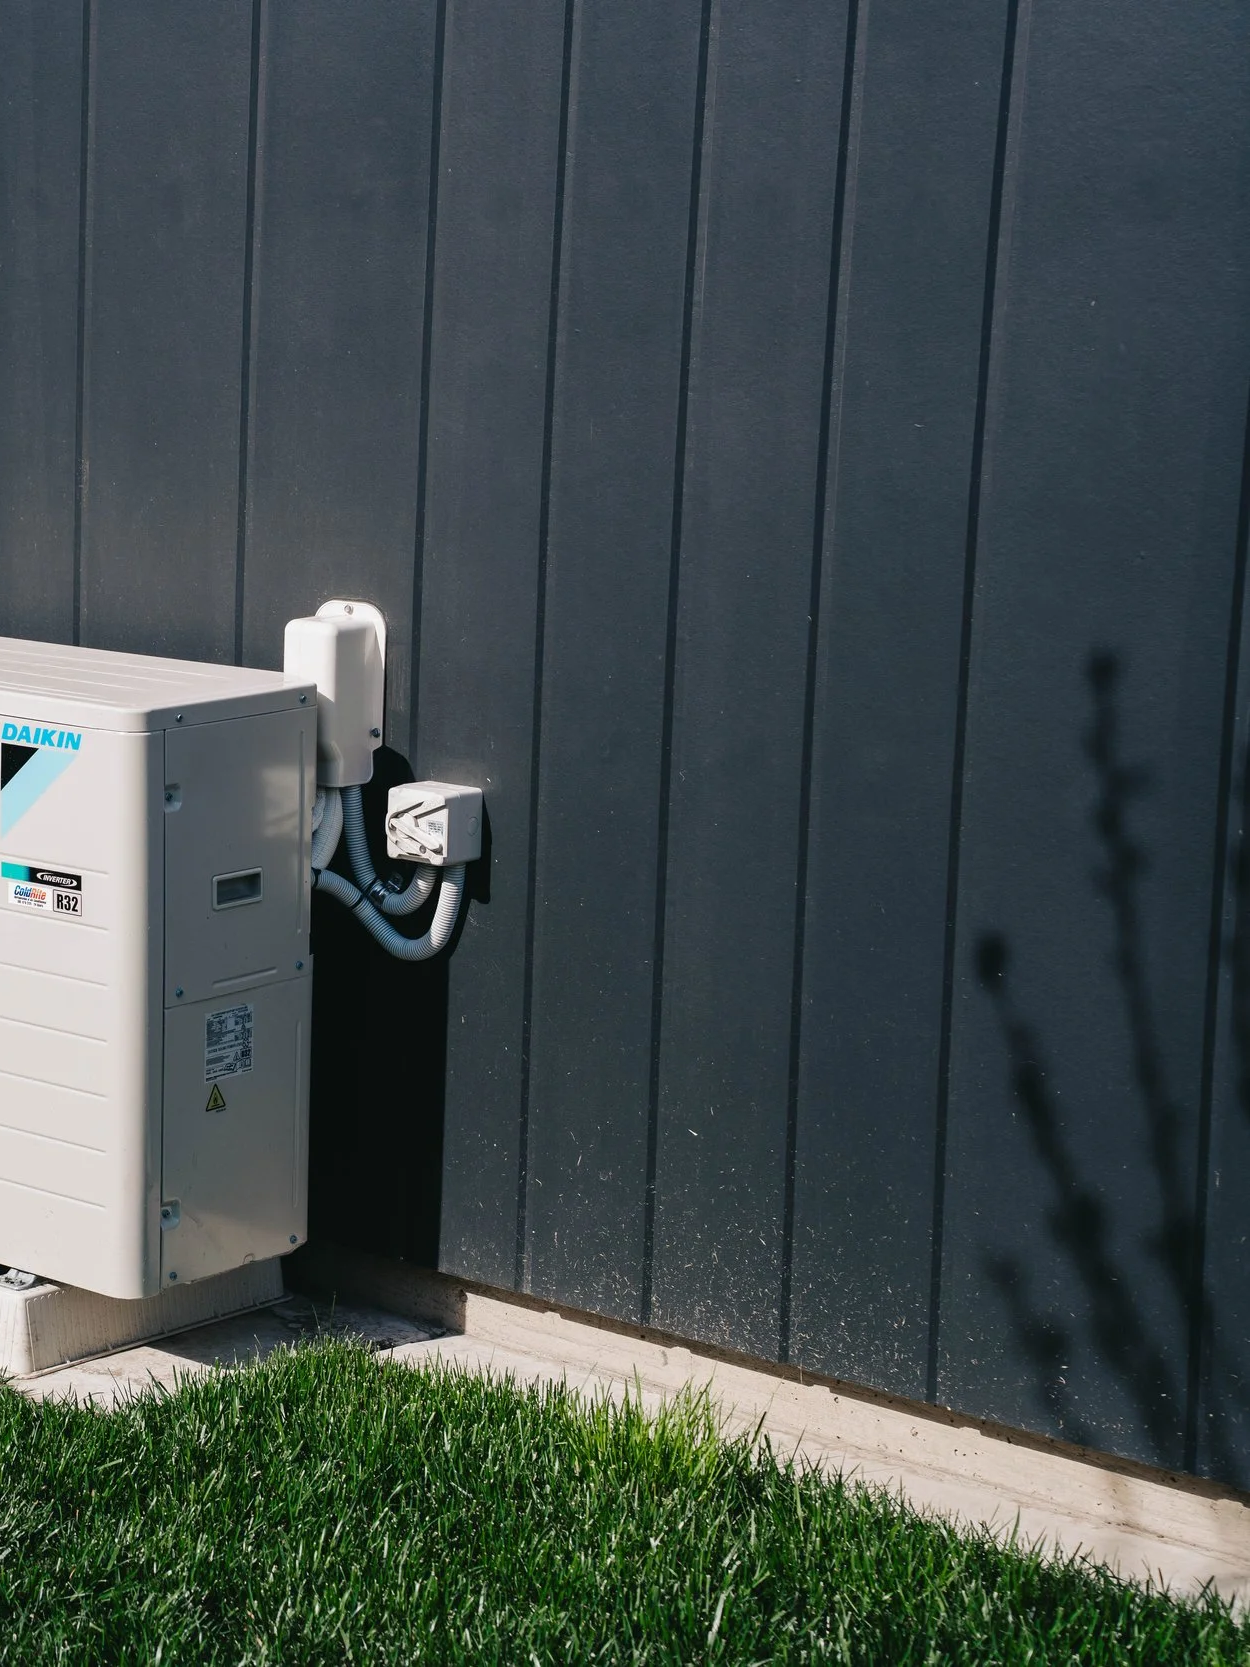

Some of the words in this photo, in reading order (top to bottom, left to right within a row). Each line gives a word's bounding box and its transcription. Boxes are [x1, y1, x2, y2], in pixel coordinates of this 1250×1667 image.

[1, 723, 81, 750] DAIKIN
[42, 874, 72, 885] INVERTER
[14, 885, 47, 900] ColdRite
[56, 894, 78, 912] R32
